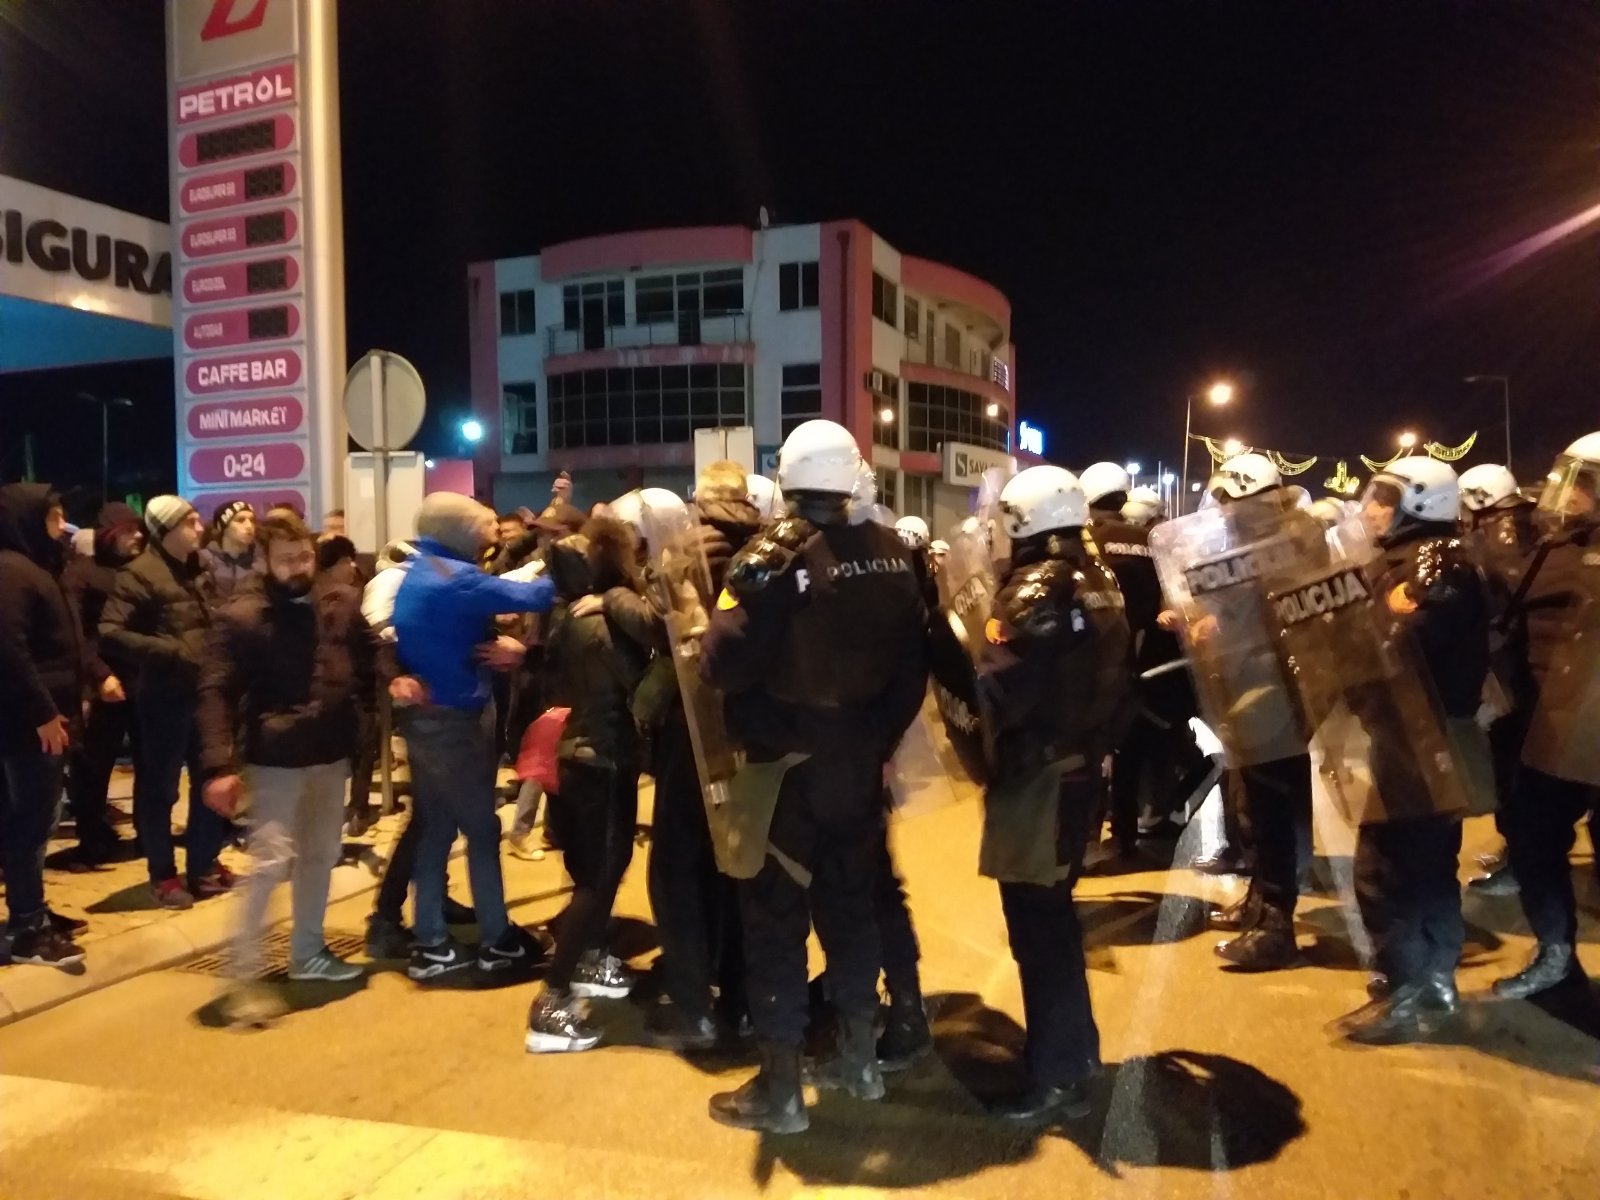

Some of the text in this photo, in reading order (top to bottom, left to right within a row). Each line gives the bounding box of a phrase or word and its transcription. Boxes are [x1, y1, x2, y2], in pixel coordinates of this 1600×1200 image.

[179, 74, 292, 119] PETROL
[198, 358, 287, 387] CAFFE BAR
[199, 406, 287, 431] MINI MARKET
[223, 452, 266, 477] 0-24
[826, 557, 909, 581] POLICIJA
